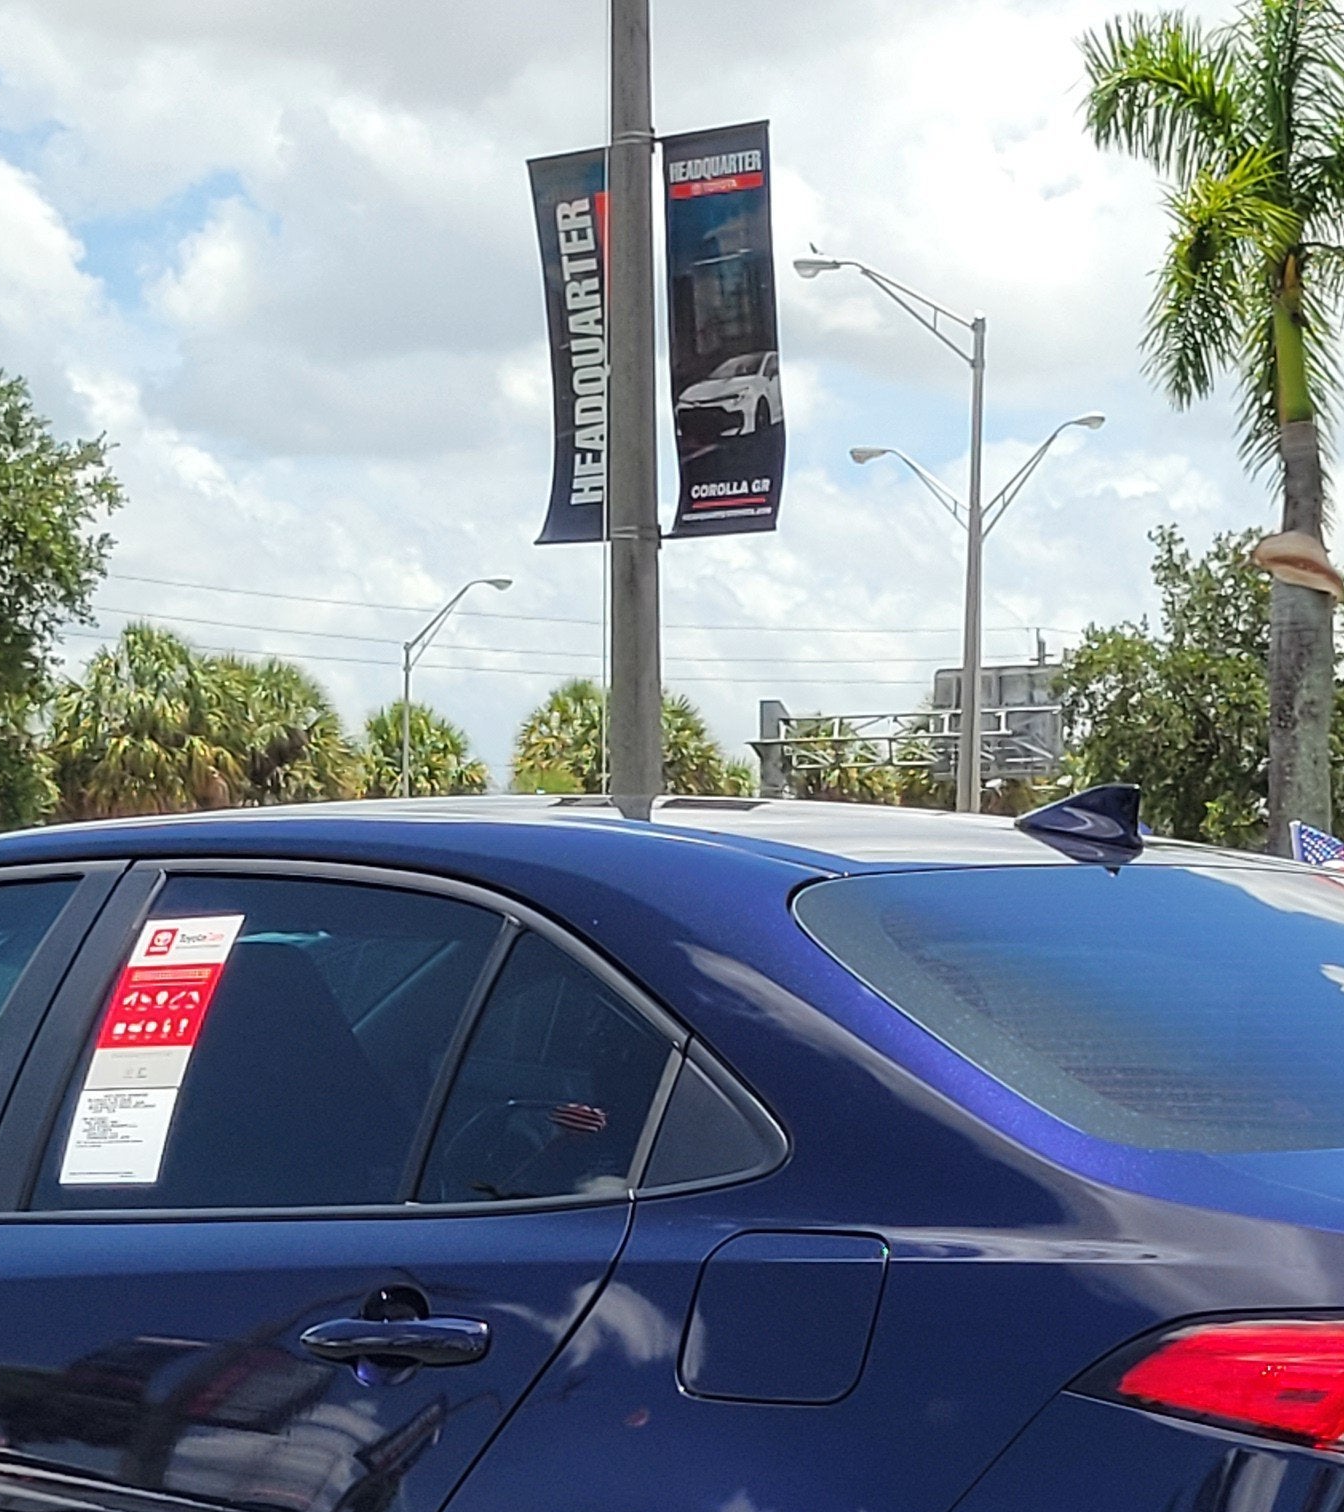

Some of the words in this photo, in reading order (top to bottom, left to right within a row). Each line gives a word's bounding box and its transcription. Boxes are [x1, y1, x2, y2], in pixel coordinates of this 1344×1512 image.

[669, 148, 762, 183] HEADQUARTER
[556, 197, 610, 505] HEADQUARTER
[691, 481, 748, 498] COROLLA
[751, 478, 771, 493] GR
